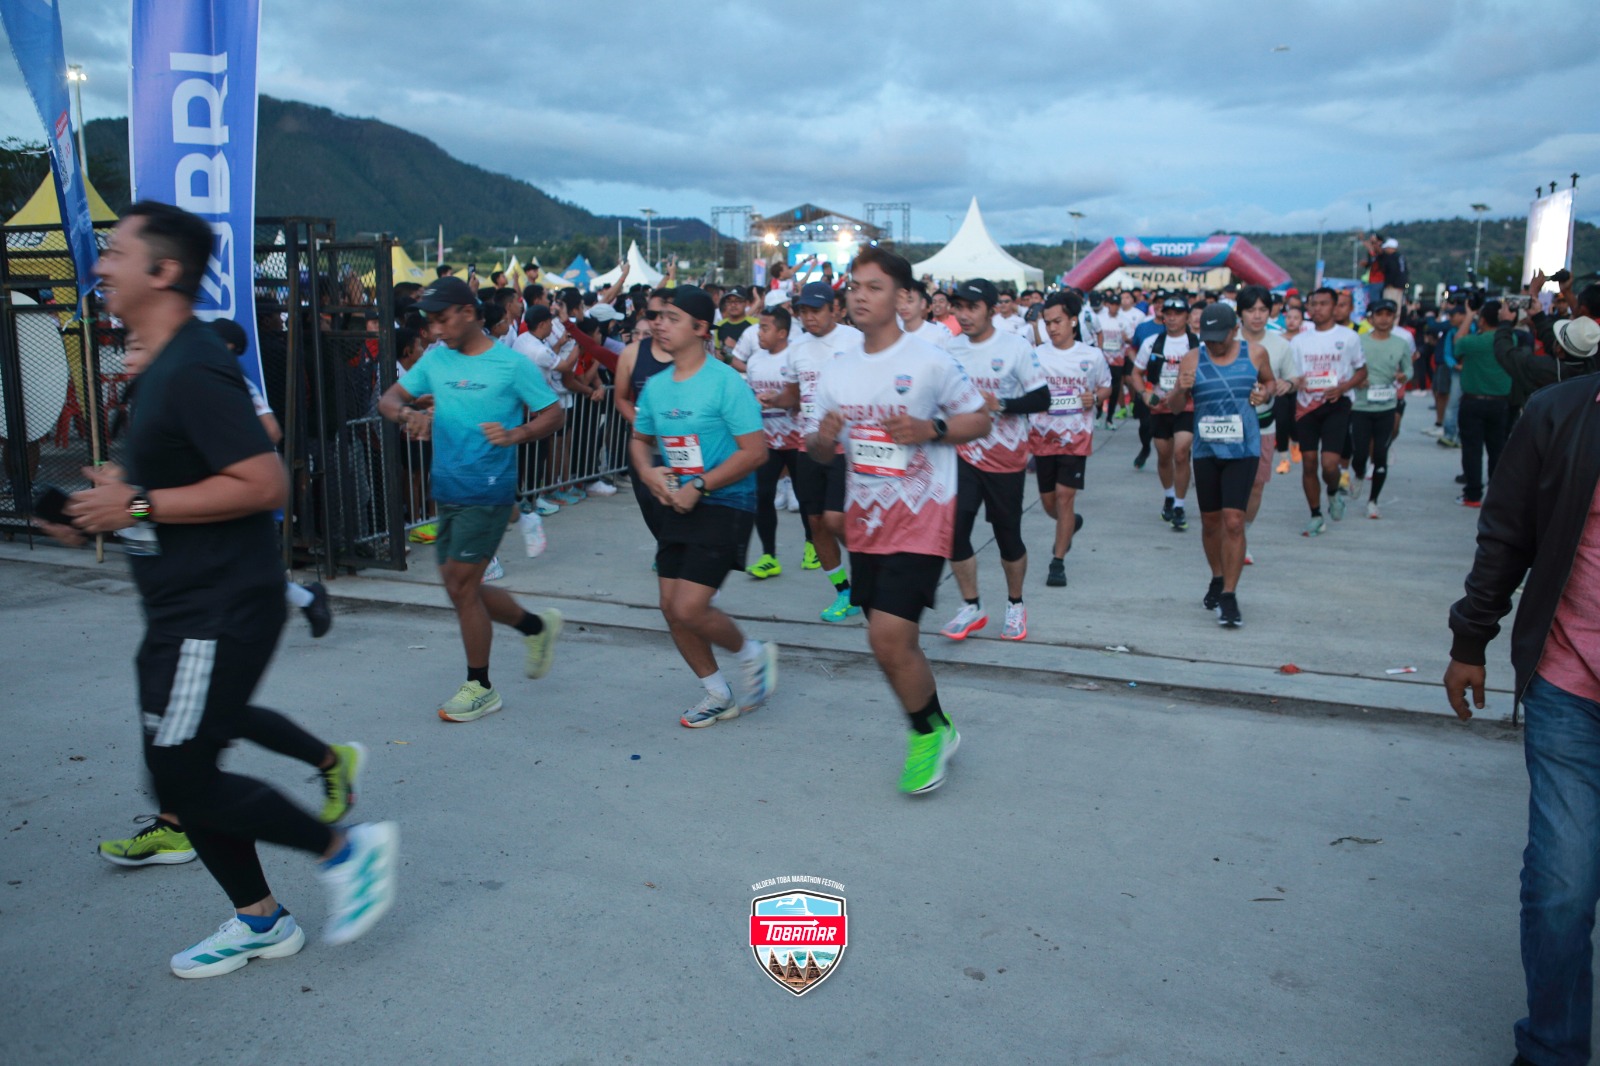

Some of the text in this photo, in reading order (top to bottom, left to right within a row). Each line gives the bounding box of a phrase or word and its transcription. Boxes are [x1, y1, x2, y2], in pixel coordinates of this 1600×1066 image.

[169, 51, 231, 214] BRI
[1151, 243, 1195, 256] START
[1131, 270, 1208, 283] ENDAGRI
[970, 377, 1000, 389] AMAR
[1051, 398, 1077, 406] 22073
[1205, 425, 1236, 434] 23074
